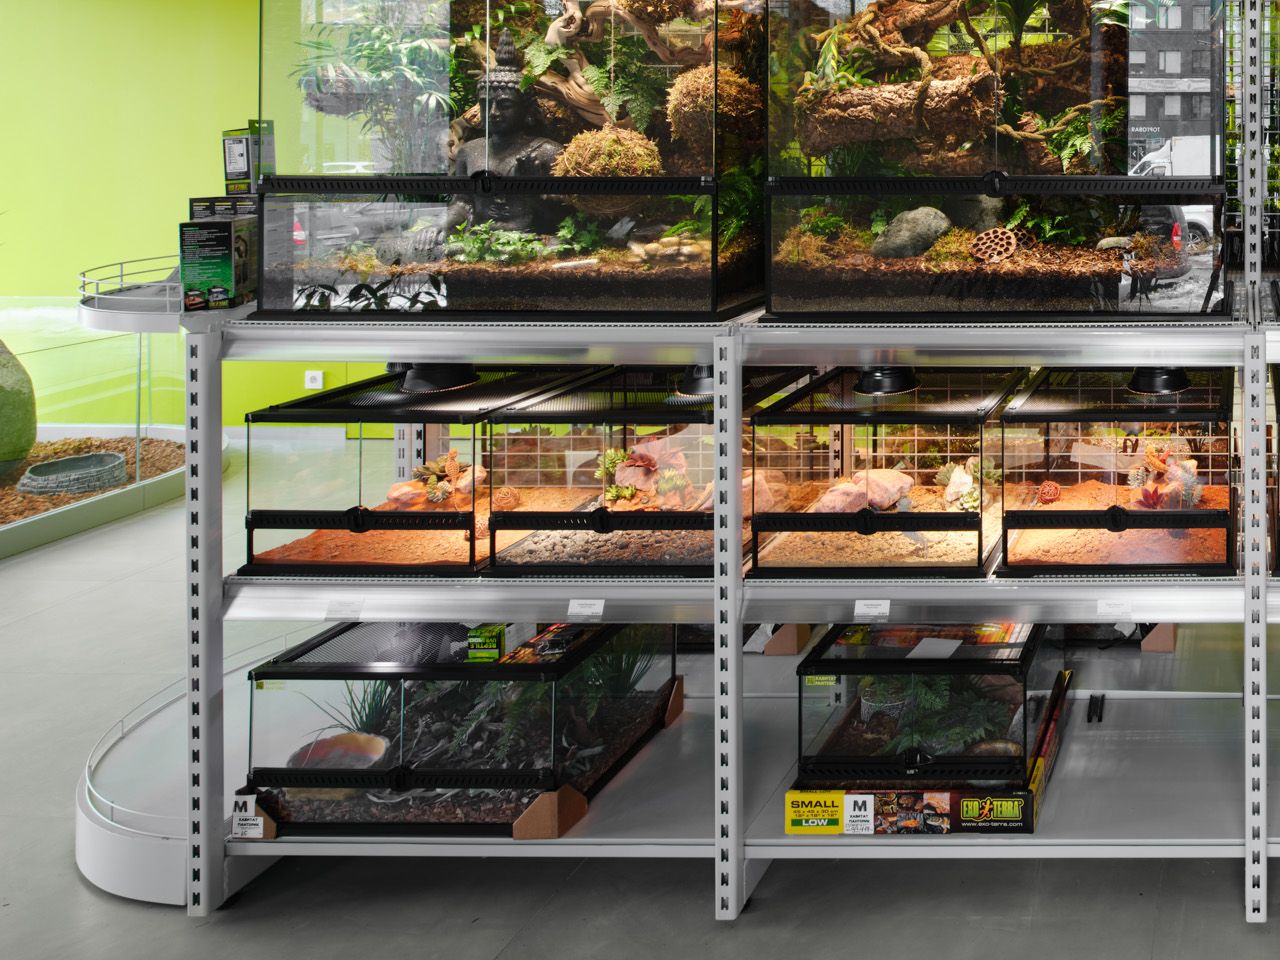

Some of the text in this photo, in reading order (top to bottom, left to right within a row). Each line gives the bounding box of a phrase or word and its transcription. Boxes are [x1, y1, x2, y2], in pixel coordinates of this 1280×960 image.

[233, 800, 248, 813] M
[791, 800, 839, 809] SMALL
[853, 799, 867, 812] M
[962, 800, 1020, 817] EXO TERRA
